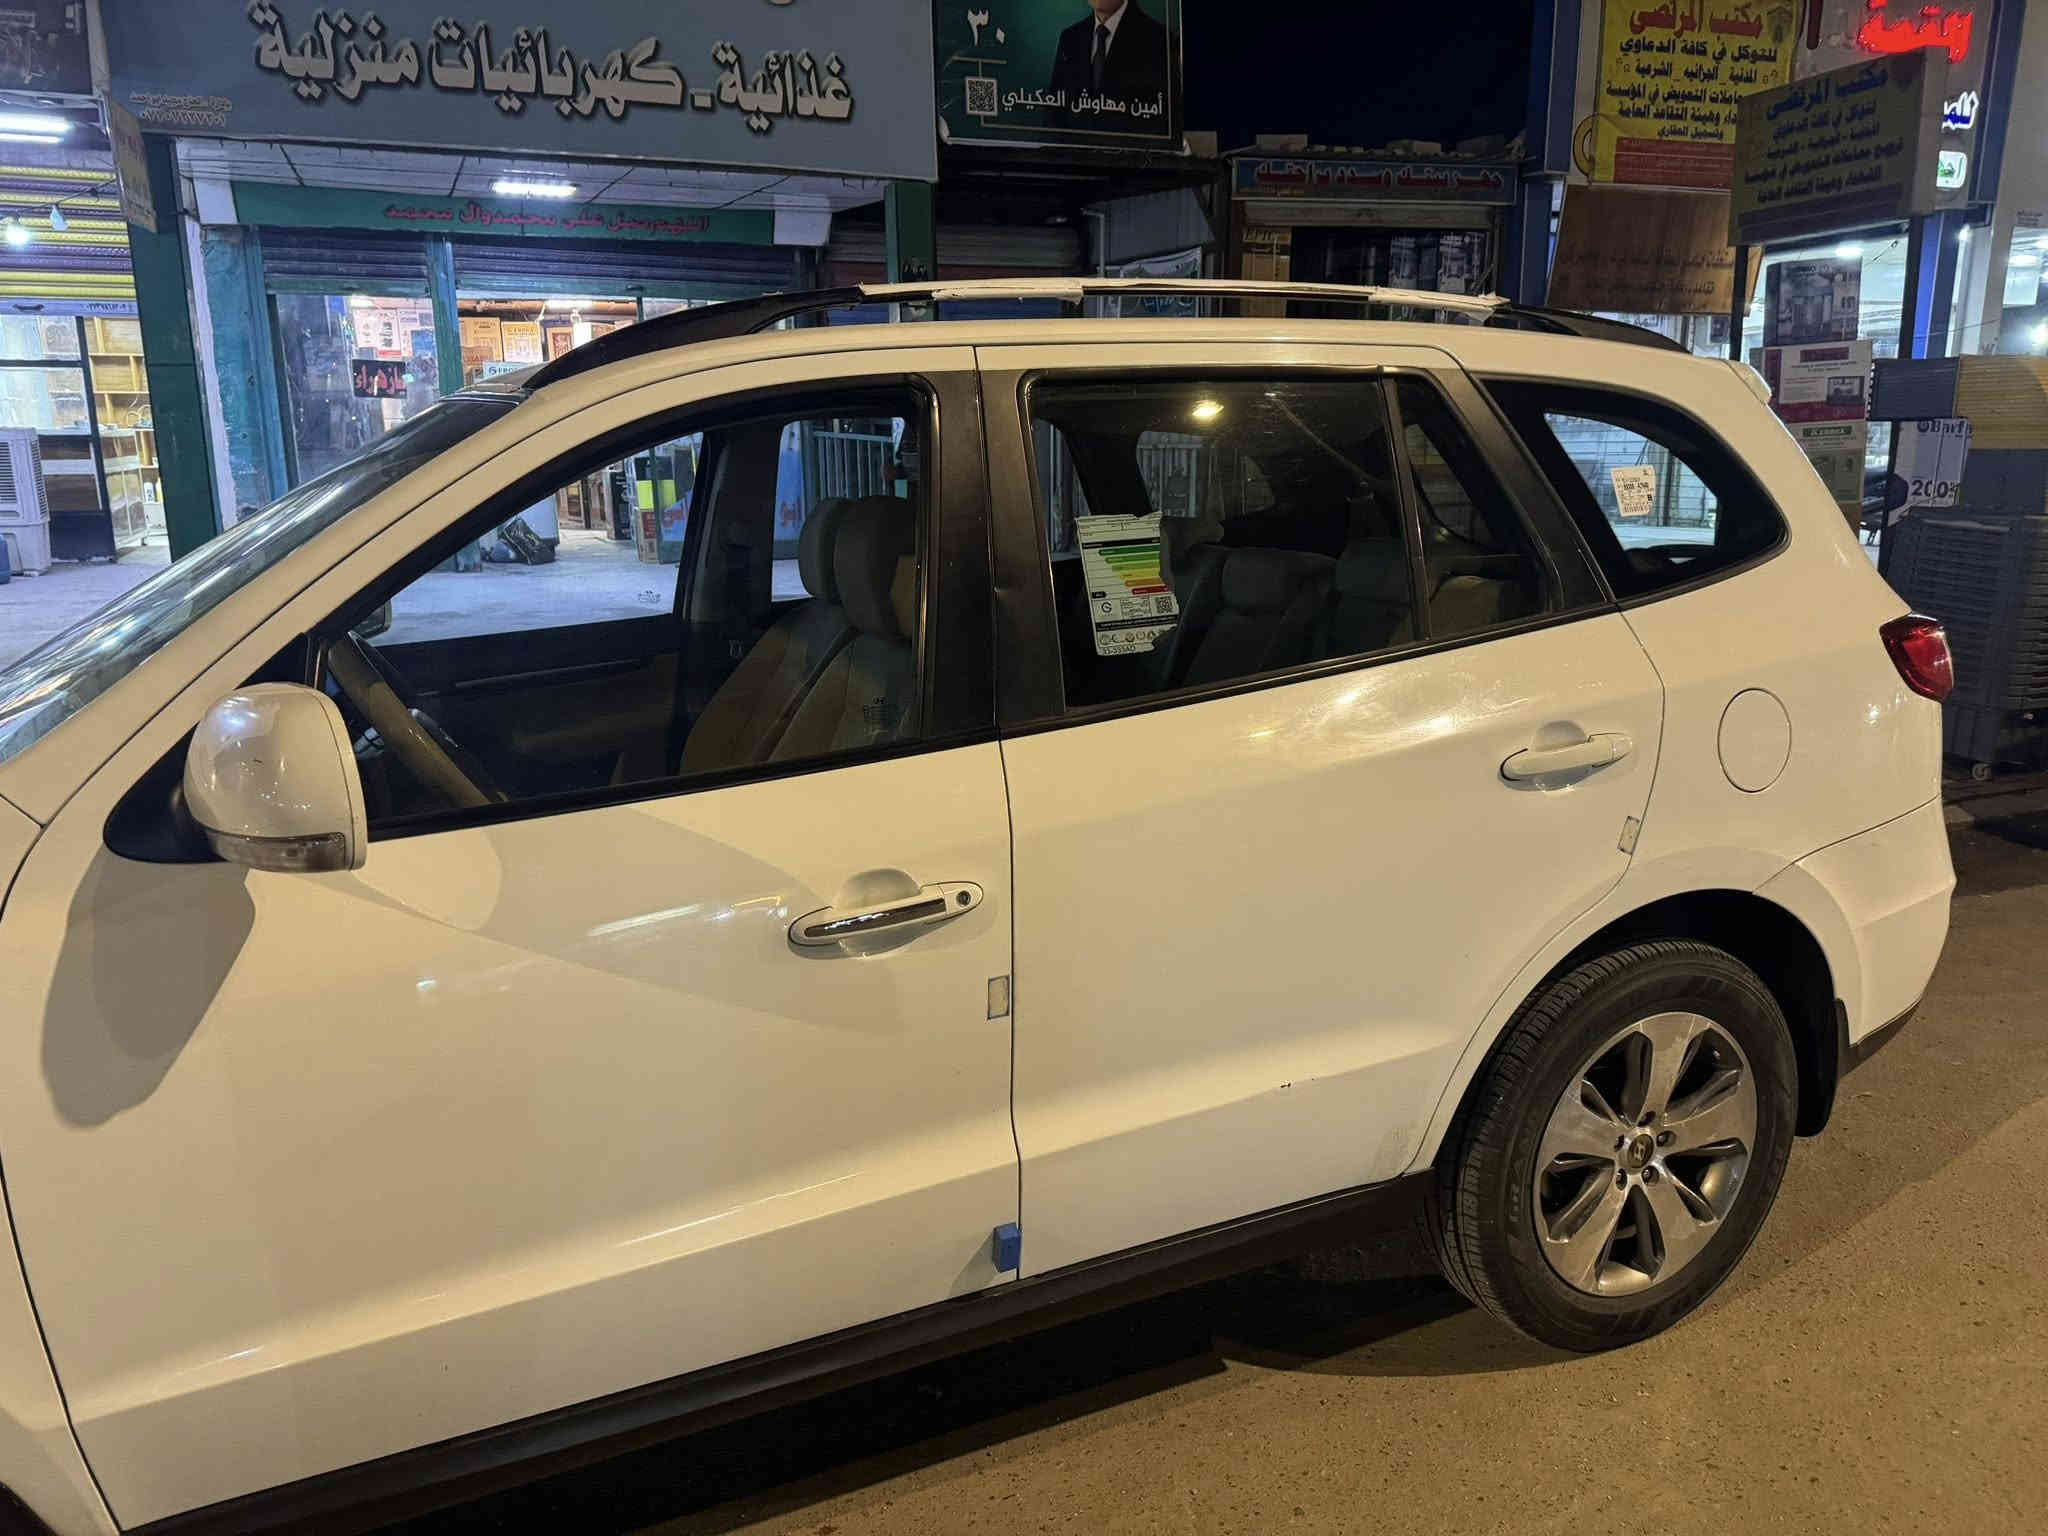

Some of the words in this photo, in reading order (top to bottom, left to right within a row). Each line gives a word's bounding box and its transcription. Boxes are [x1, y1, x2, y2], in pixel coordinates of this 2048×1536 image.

[1630, 0, 1704, 38] المرتضى
[1709, 1, 1763, 38] مكتب
[249, 0, 420, 100] منزلية
[1681, 40, 1707, 56] كافة
[1712, 43, 1726, 63] في
[1731, 45, 1777, 63] للتوكل
[430, 17, 684, 118] كهربائيات
[1635, 60, 1672, 79] الشرعية
[1728, 66, 1757, 83] المدنية
[713, 41, 853, 133] غذائية
[1649, 84, 1659, 104] في
[1662, 85, 1706, 104] التعويض
[1002, 87, 1065, 112] العكيلي
[1071, 89, 1126, 114] مهاوش
[1130, 92, 1163, 118] أمين
[1618, 102, 1650, 118] العامة
[385, 205, 453, 220] محمد
